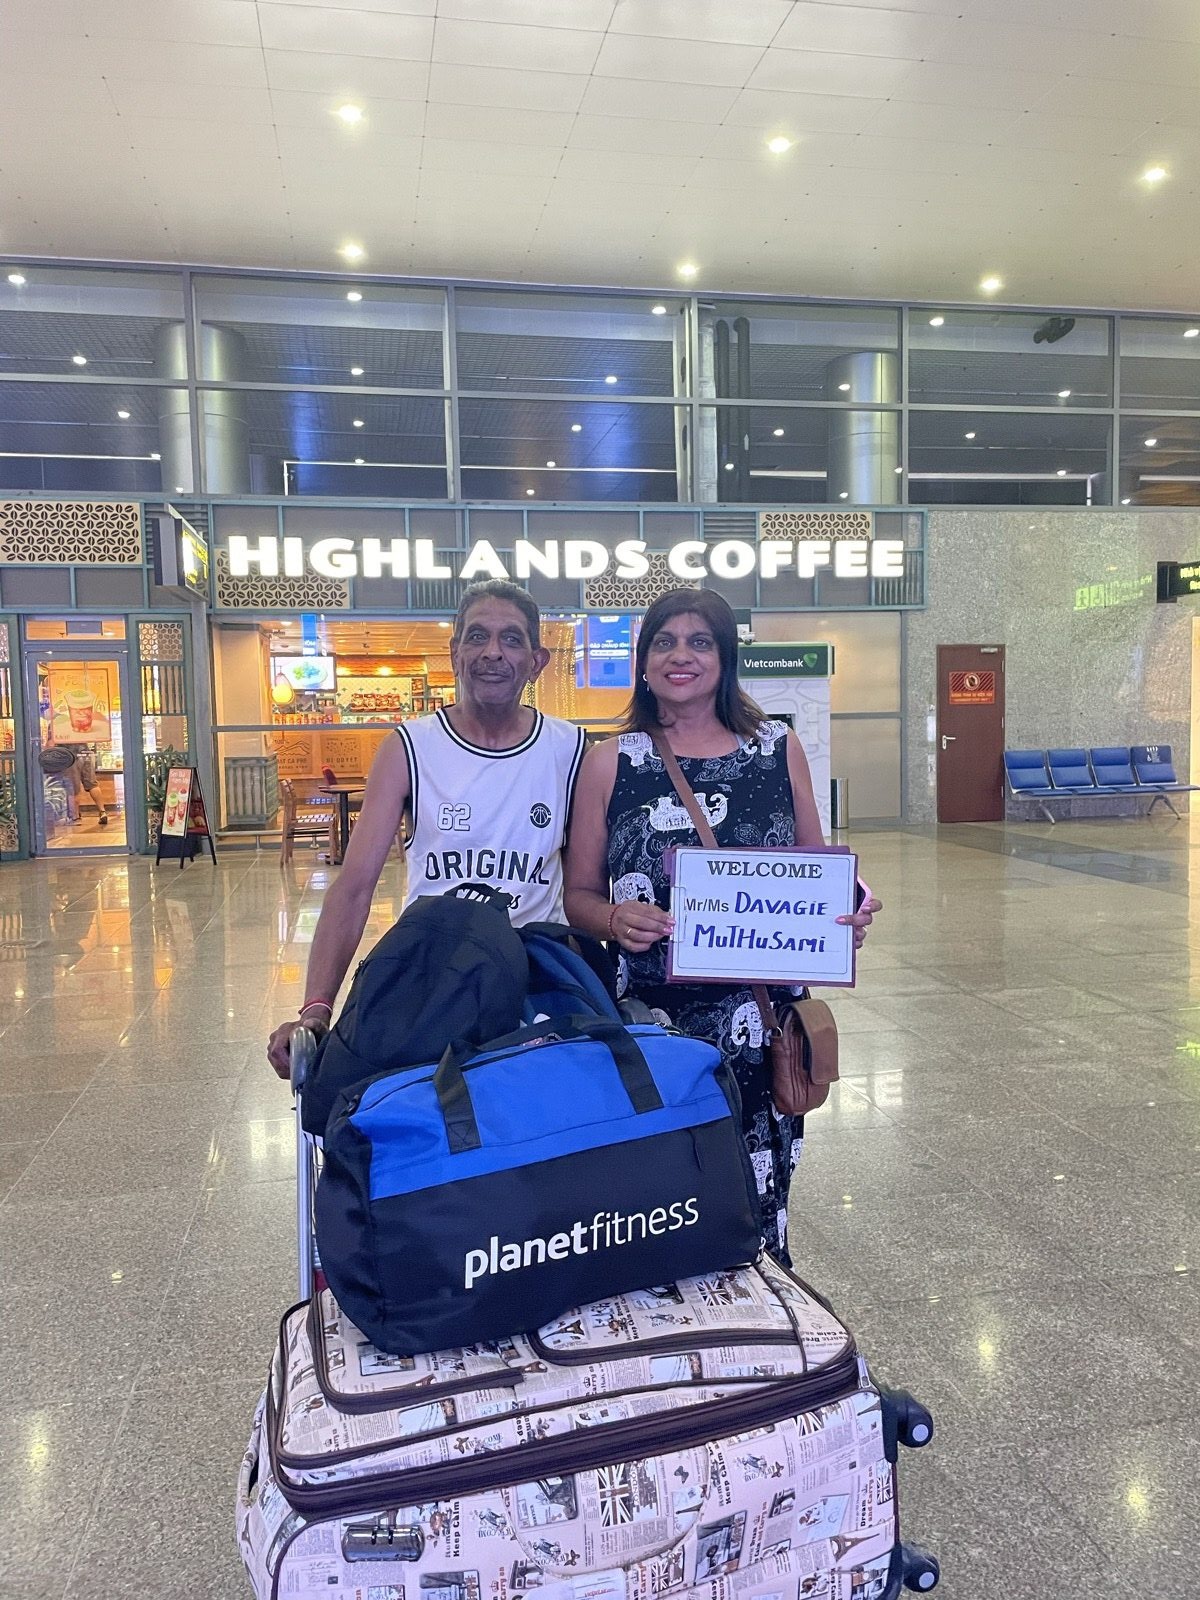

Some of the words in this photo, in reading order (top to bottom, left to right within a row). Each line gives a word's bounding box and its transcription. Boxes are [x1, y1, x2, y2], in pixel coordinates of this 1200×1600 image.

[228, 535, 650, 579] HIGHLANDS
[668, 540, 904, 579] COFFEE
[744, 658, 804, 668] Vietcombank
[437, 802, 471, 832] 62
[425, 849, 550, 885] ORIGINAL
[707, 860, 823, 879] WELCOME
[685, 898, 730, 912] Mr/Ms
[464, 1198, 699, 1290] planetfitness
[723, 1479, 732, 1504] Keep
